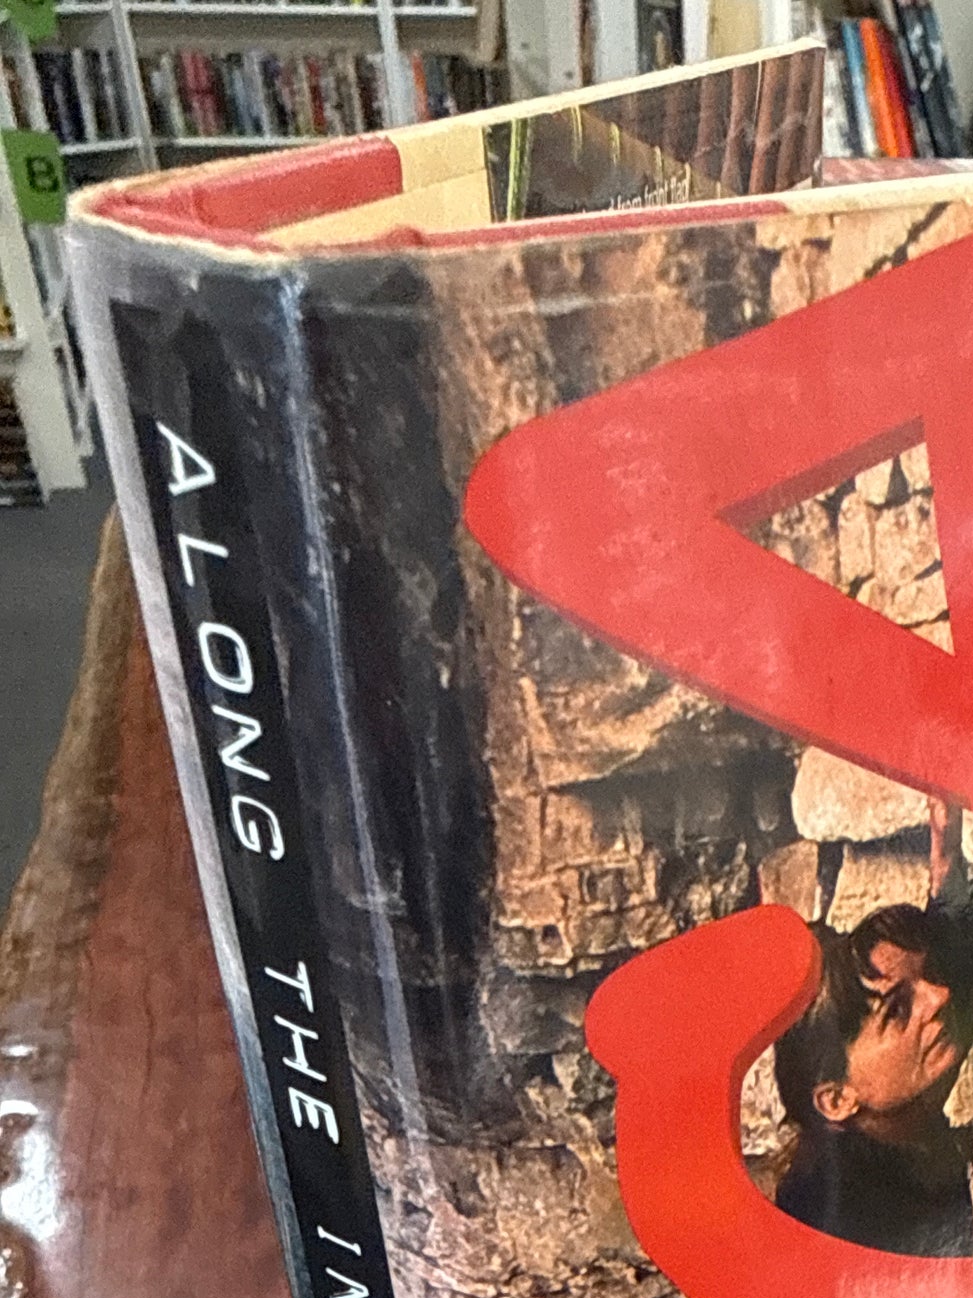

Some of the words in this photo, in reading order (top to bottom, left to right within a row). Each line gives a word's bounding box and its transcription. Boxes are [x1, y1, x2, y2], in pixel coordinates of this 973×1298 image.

[26, 156, 60, 193] B
[155, 420, 285, 862] ALONG
[263, 960, 341, 1145] THE
